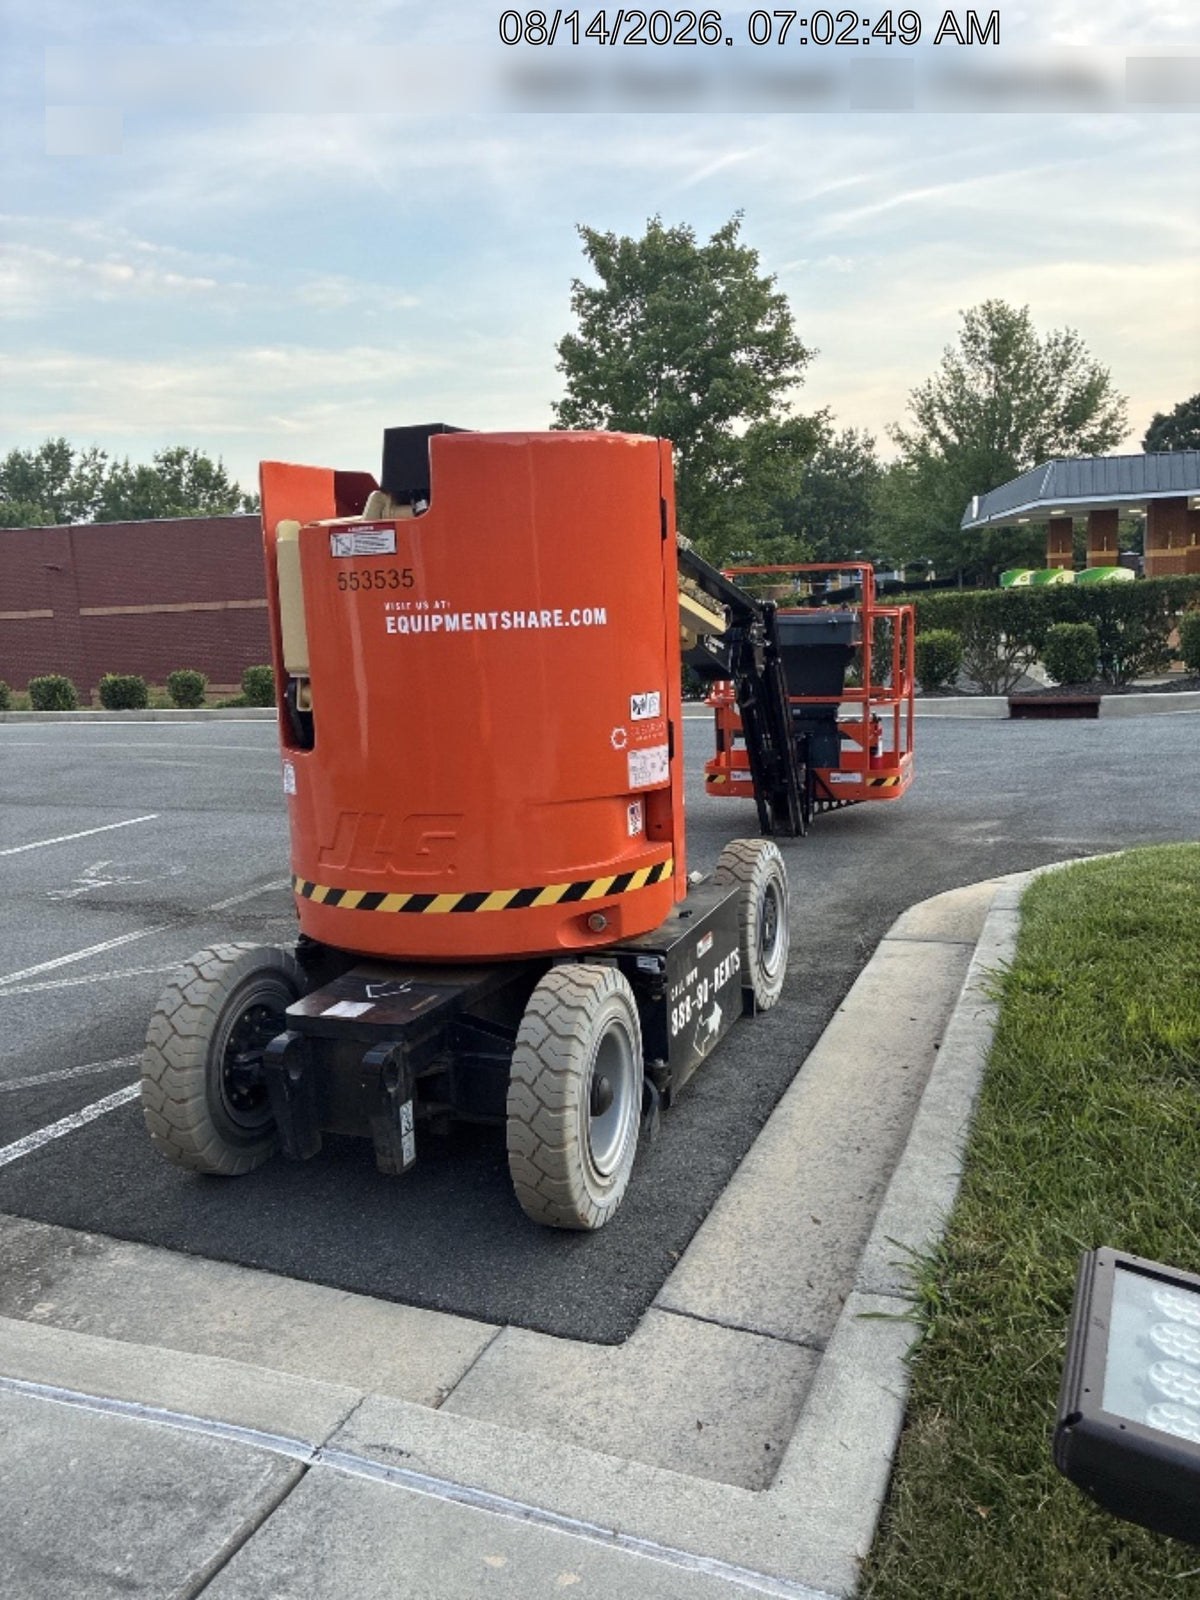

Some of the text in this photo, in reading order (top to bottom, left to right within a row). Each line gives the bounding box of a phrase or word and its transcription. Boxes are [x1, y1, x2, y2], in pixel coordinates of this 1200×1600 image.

[337, 568, 415, 591] 553535
[415, 601, 430, 610] US
[385, 607, 608, 634] EQUIPMENTSHARE.COM
